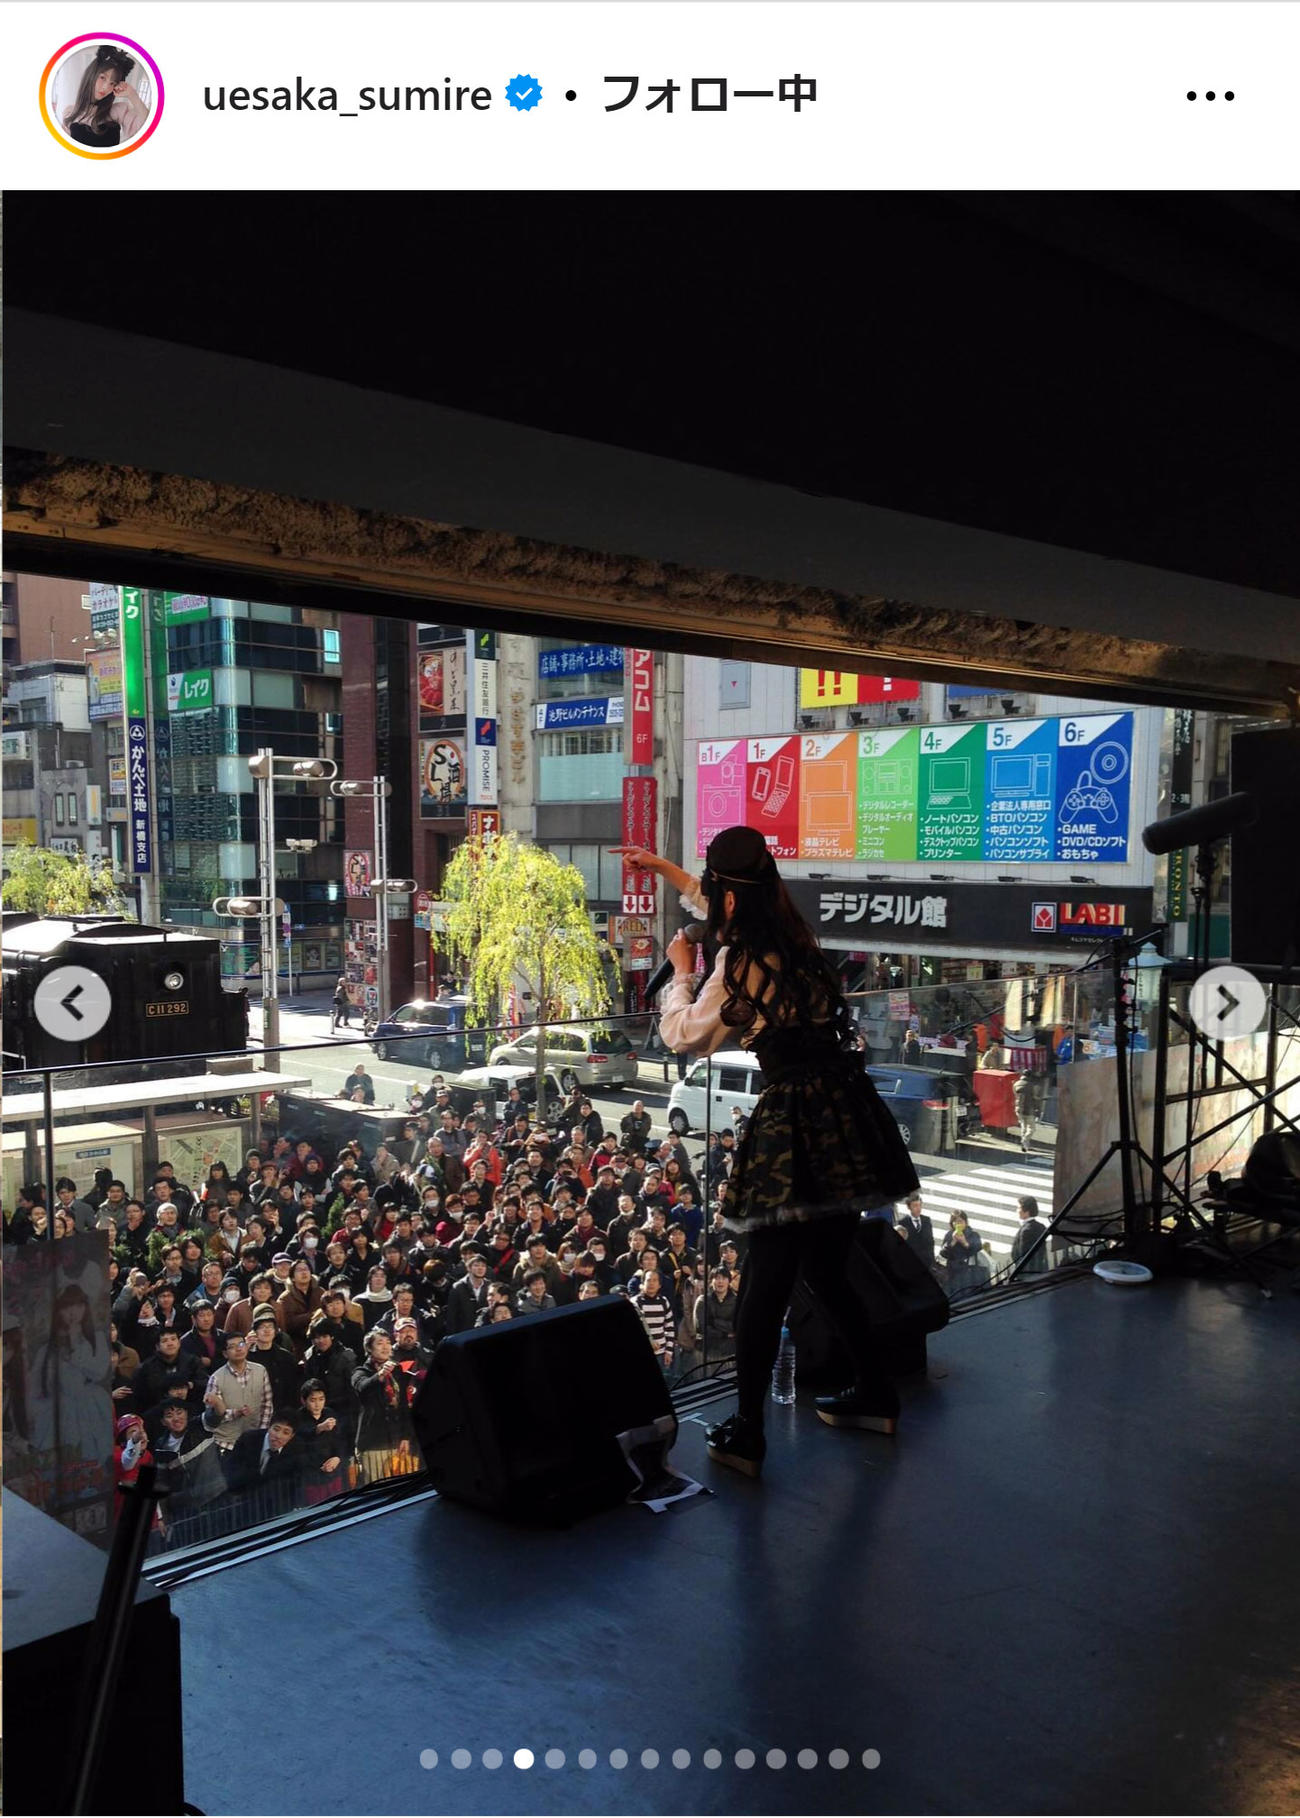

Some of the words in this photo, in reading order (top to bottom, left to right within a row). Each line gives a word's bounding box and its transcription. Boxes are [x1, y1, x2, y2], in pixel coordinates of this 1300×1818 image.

[184, 679, 210, 699] レイク
[634, 648, 651, 712] アコム
[636, 733, 649, 744] 6F
[924, 731, 942, 750] 4F
[993, 727, 1012, 747] 5F
[1065, 722, 1085, 742] 6F
[753, 742, 766, 758] 1F
[805, 739, 821, 757] 2F
[863, 735, 880, 754] 3F
[131, 745, 147, 813] かんべ土地
[481, 749, 490, 792] PROMISE
[1062, 824, 1097, 834] GAME
[135, 819, 147, 864] 新橋支店
[1062, 836, 1127, 848] DVD/CDソフト
[1061, 849, 1099, 860] おもちゃ
[820, 892, 947, 928] デジタル館
[1059, 902, 1125, 926] LABI
[167, 1003, 186, 1014] 292
